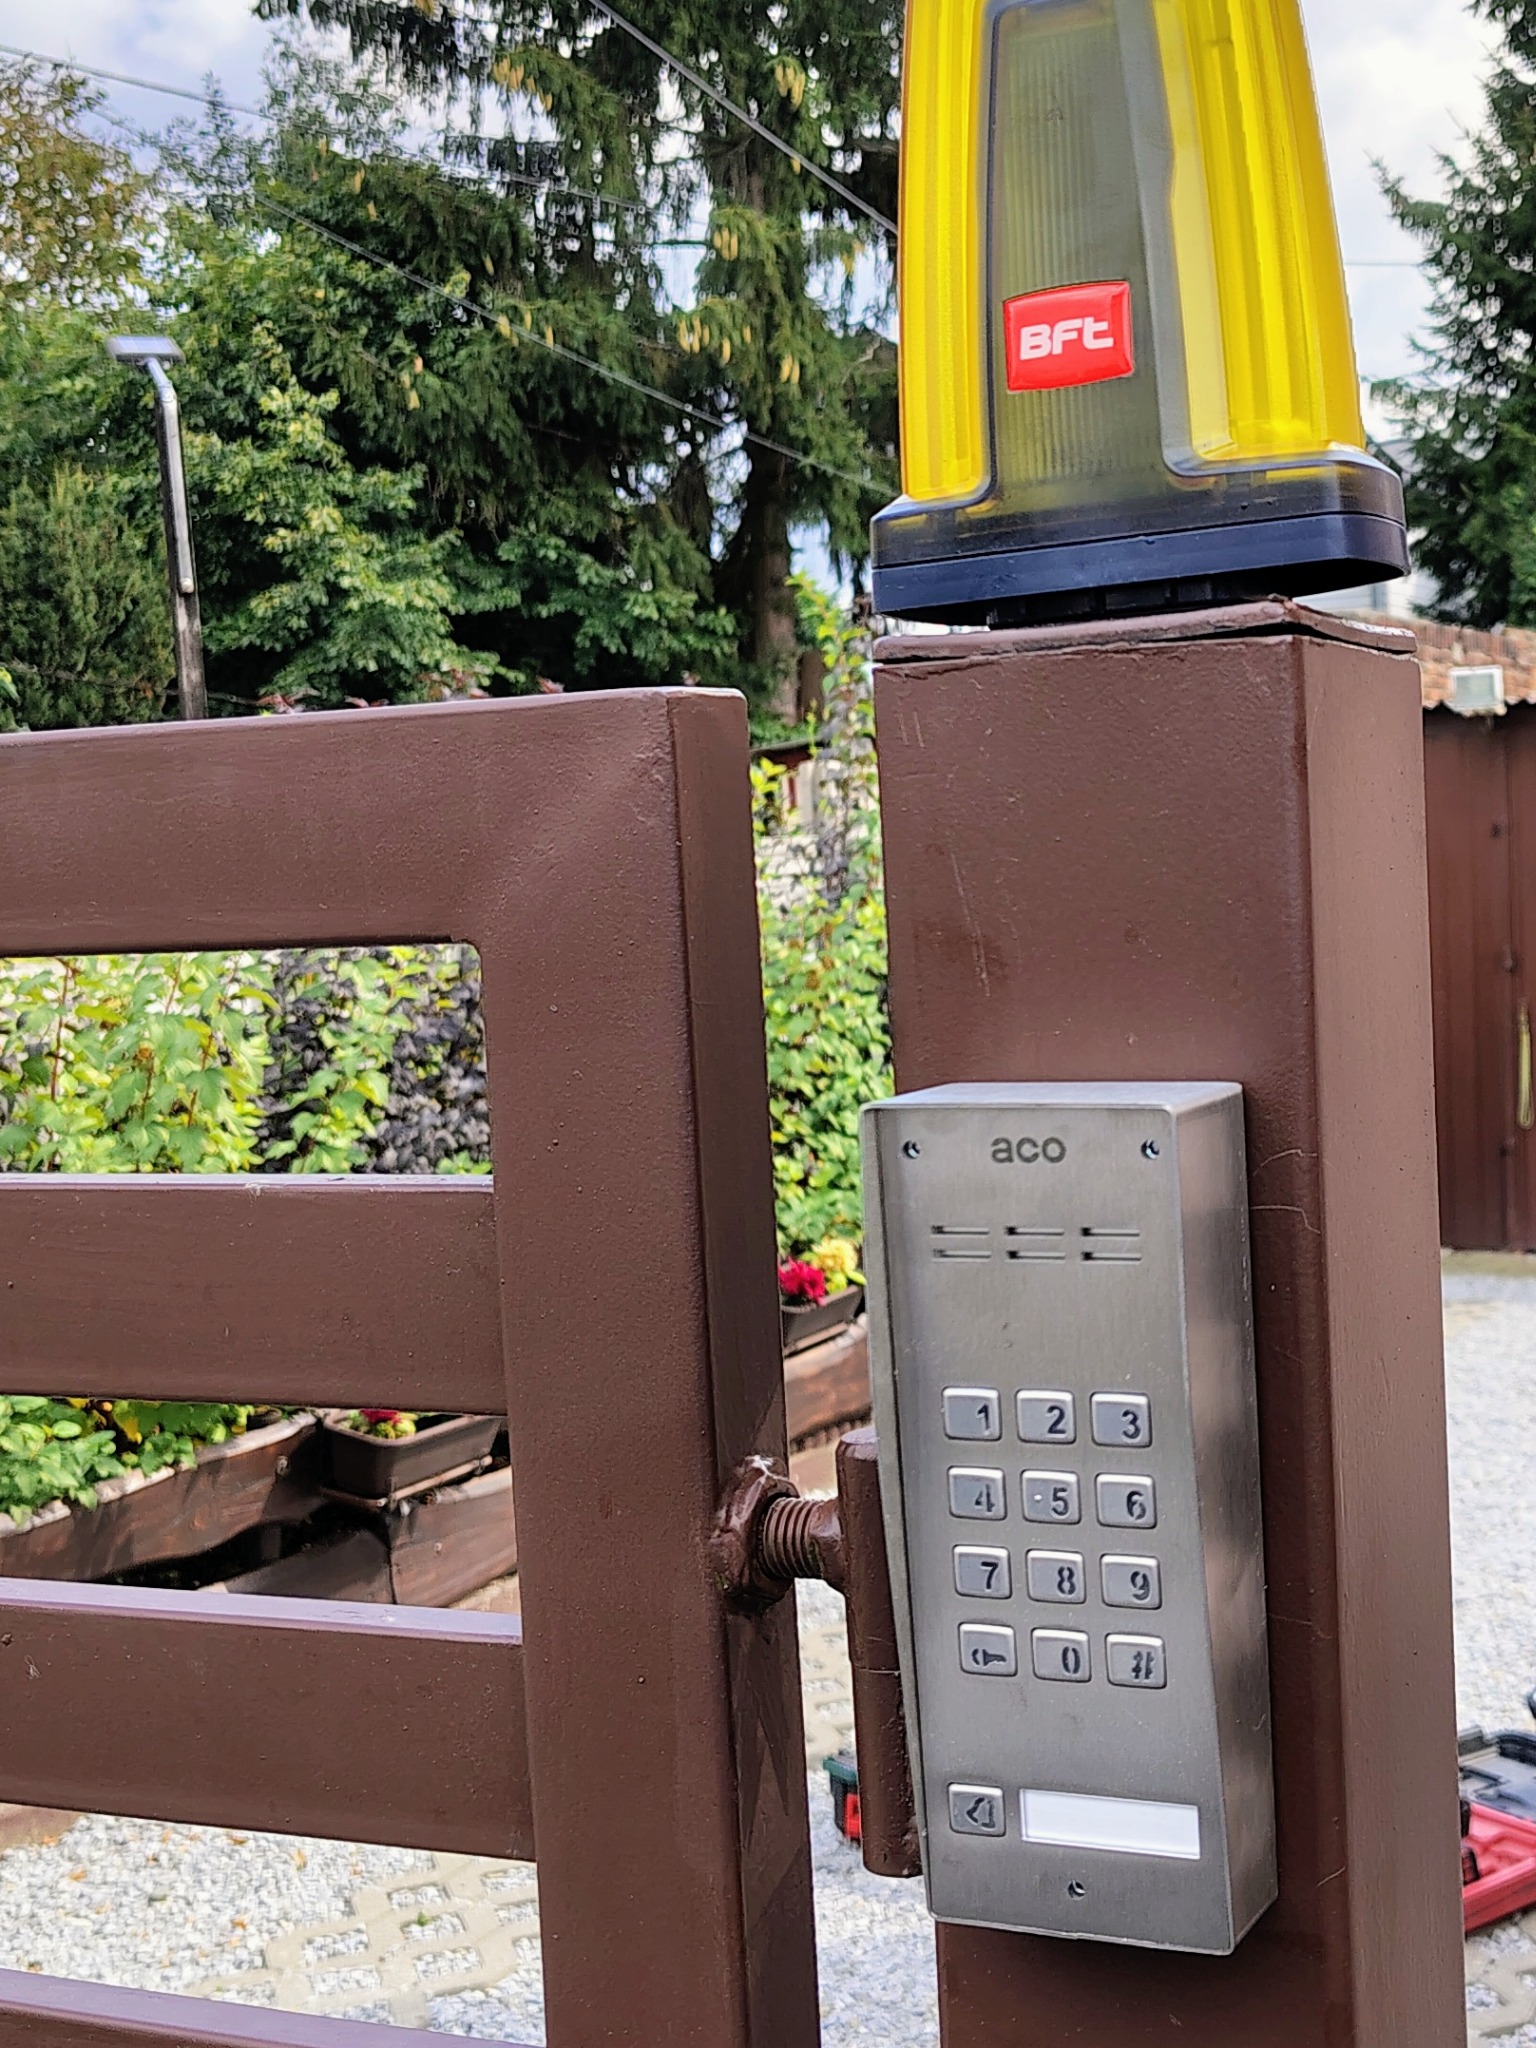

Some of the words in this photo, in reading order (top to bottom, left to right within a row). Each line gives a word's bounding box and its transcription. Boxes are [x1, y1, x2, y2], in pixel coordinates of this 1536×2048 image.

[991, 1137, 1067, 1163] aco
[977, 1404, 990, 1431] 1
[1047, 1405, 1066, 1434] 2
[1122, 1410, 1140, 1439] 3
[975, 1484, 995, 1512] 4
[1052, 1487, 1069, 1516] 5
[1127, 1491, 1146, 1520] 6
[981, 1561, 999, 1590] 7
[1057, 1567, 1076, 1595] 8
[1130, 1571, 1150, 1600] 9
[1062, 1646, 1080, 1674] 0
